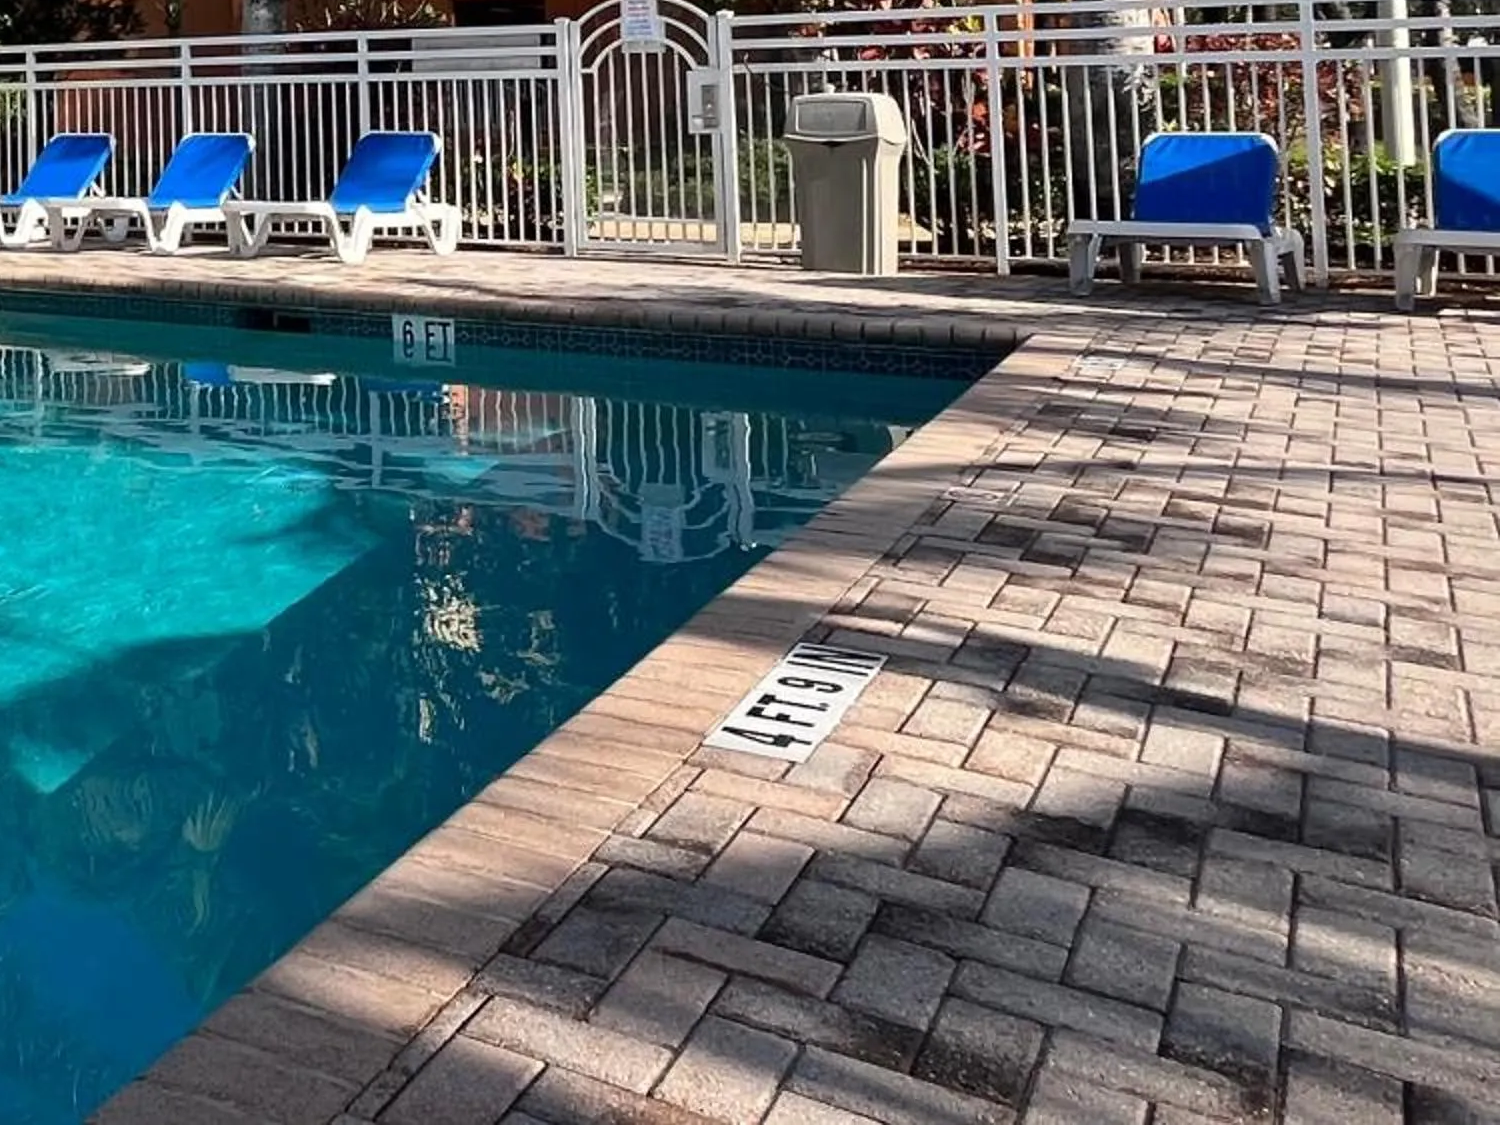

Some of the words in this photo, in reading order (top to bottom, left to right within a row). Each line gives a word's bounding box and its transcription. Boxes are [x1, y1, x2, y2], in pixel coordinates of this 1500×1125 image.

[786, 644, 884, 678] IN
[776, 675, 844, 694] 9
[721, 726, 813, 748] 4
